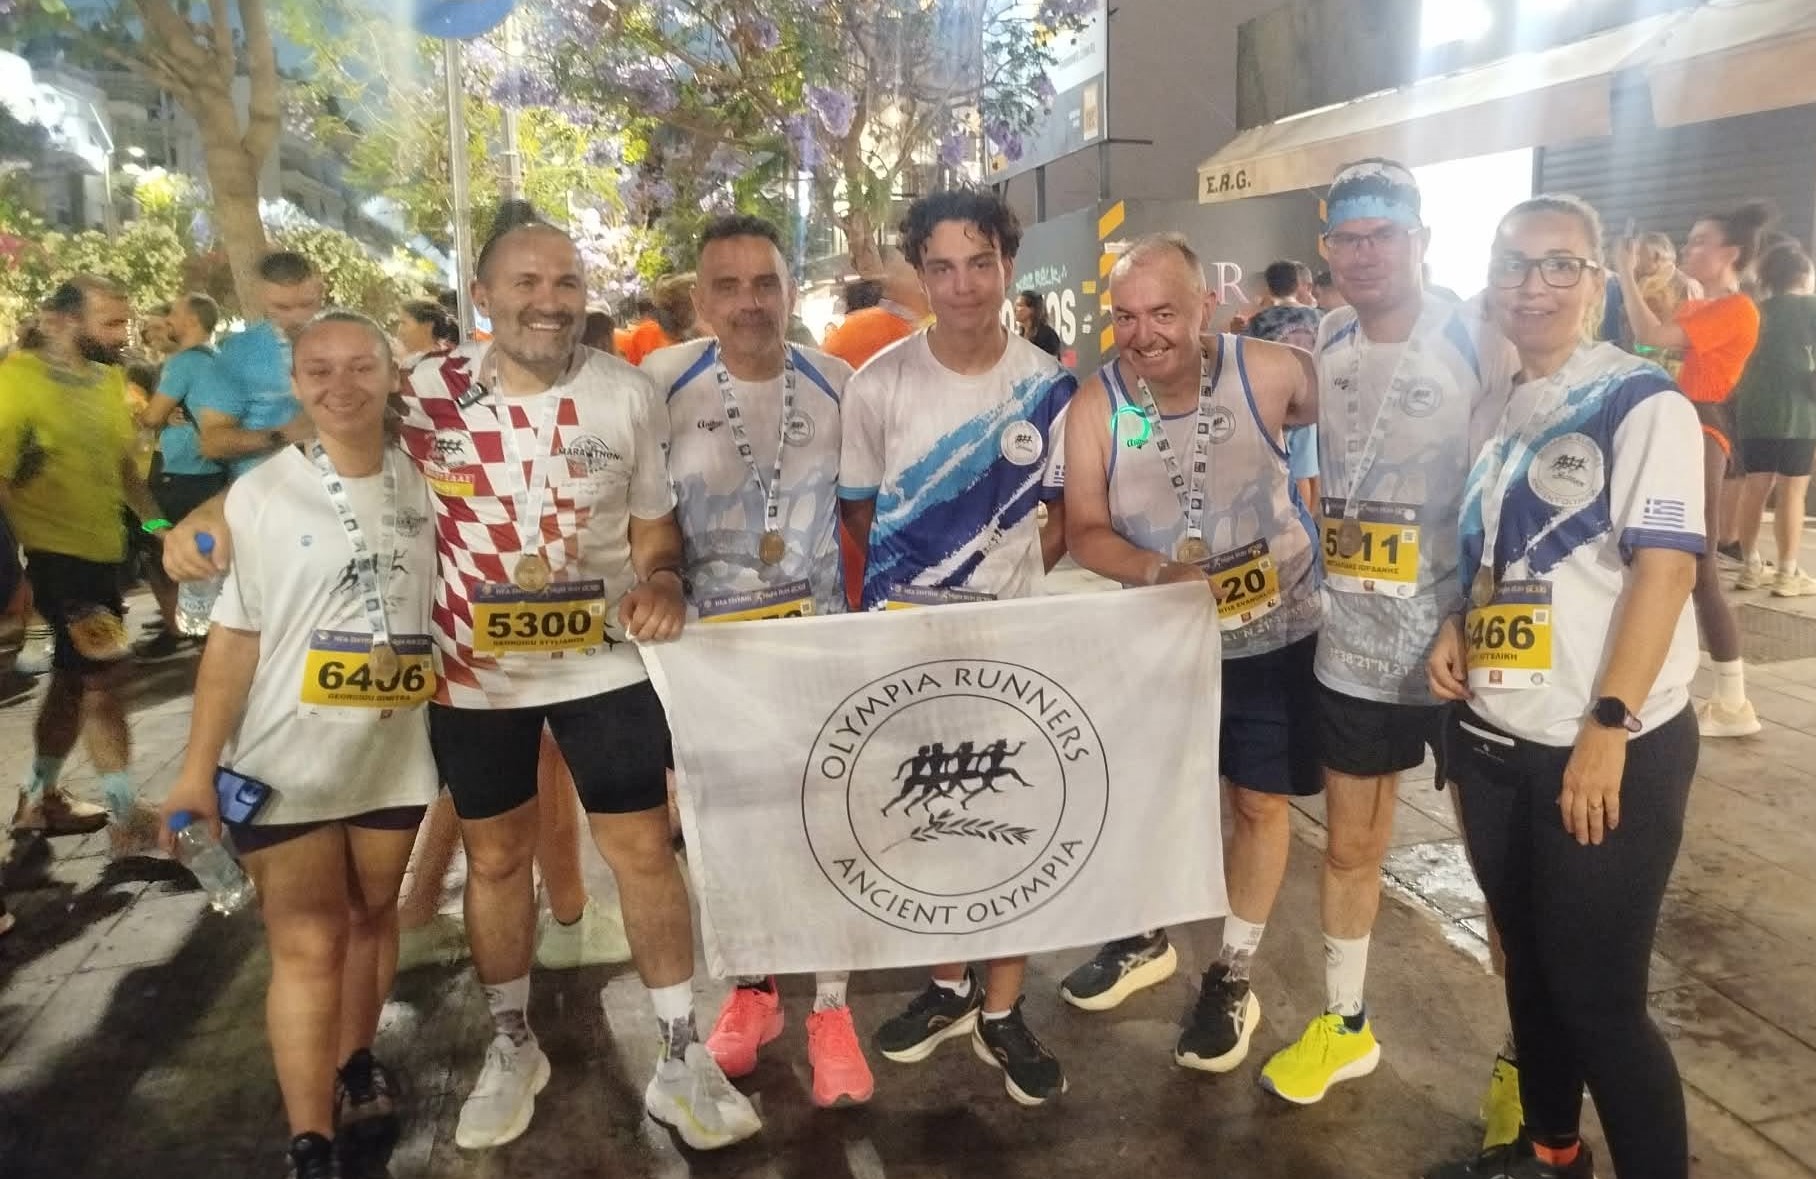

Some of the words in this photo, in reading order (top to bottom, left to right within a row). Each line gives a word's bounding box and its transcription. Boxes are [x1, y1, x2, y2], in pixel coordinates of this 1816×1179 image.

[1326, 528, 1399, 565] 511
[1216, 569, 1266, 606] 20
[487, 610, 592, 638] 5300
[821, 672, 942, 780] OLYMPIA
[954, 667, 1090, 763] RUNNERS
[832, 857, 959, 925] ANCIENT
[965, 838, 1084, 924] OLYMPIA
